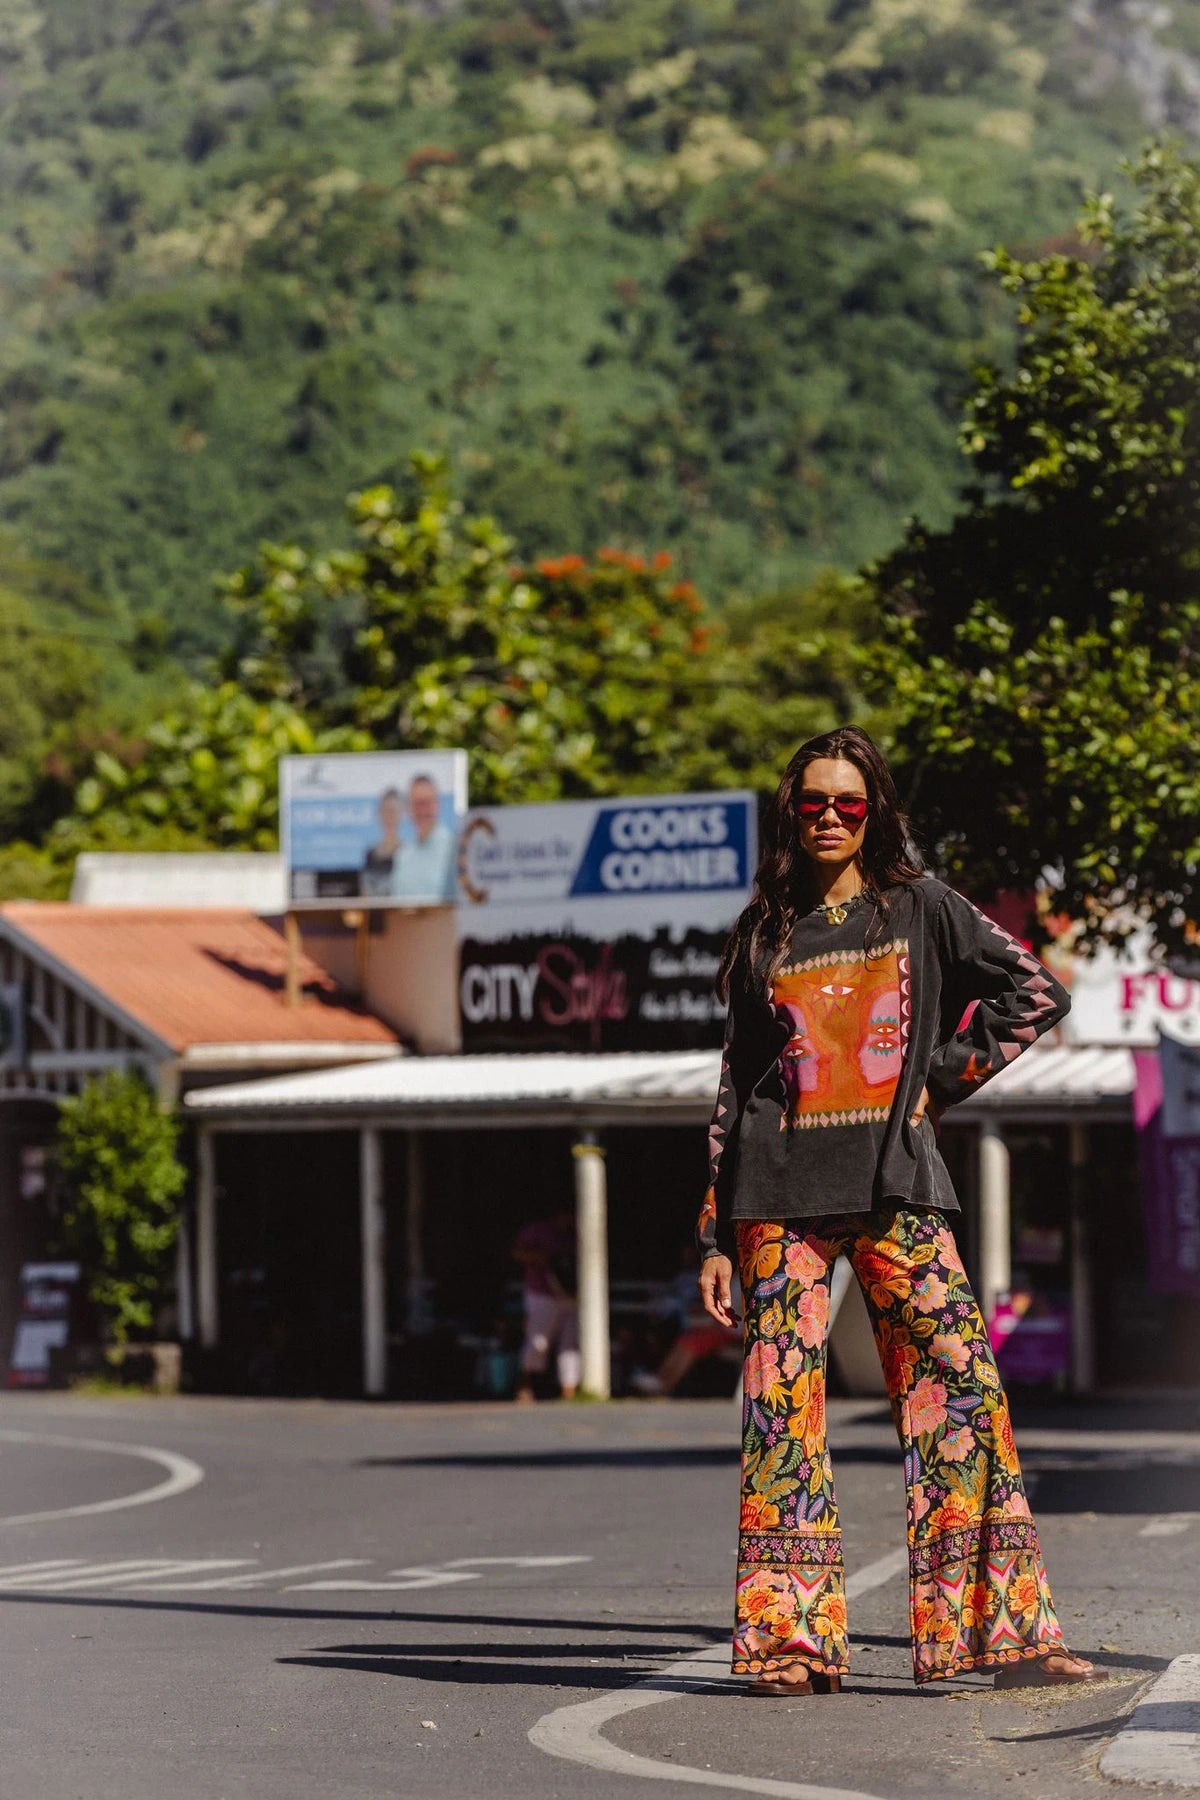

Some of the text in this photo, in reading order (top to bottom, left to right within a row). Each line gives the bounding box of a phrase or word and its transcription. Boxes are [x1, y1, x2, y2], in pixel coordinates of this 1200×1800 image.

[611, 806, 728, 849] COOKS
[600, 846, 740, 890] CORNER
[461, 963, 539, 1022] CITY
[1119, 974, 1200, 1012] FU
